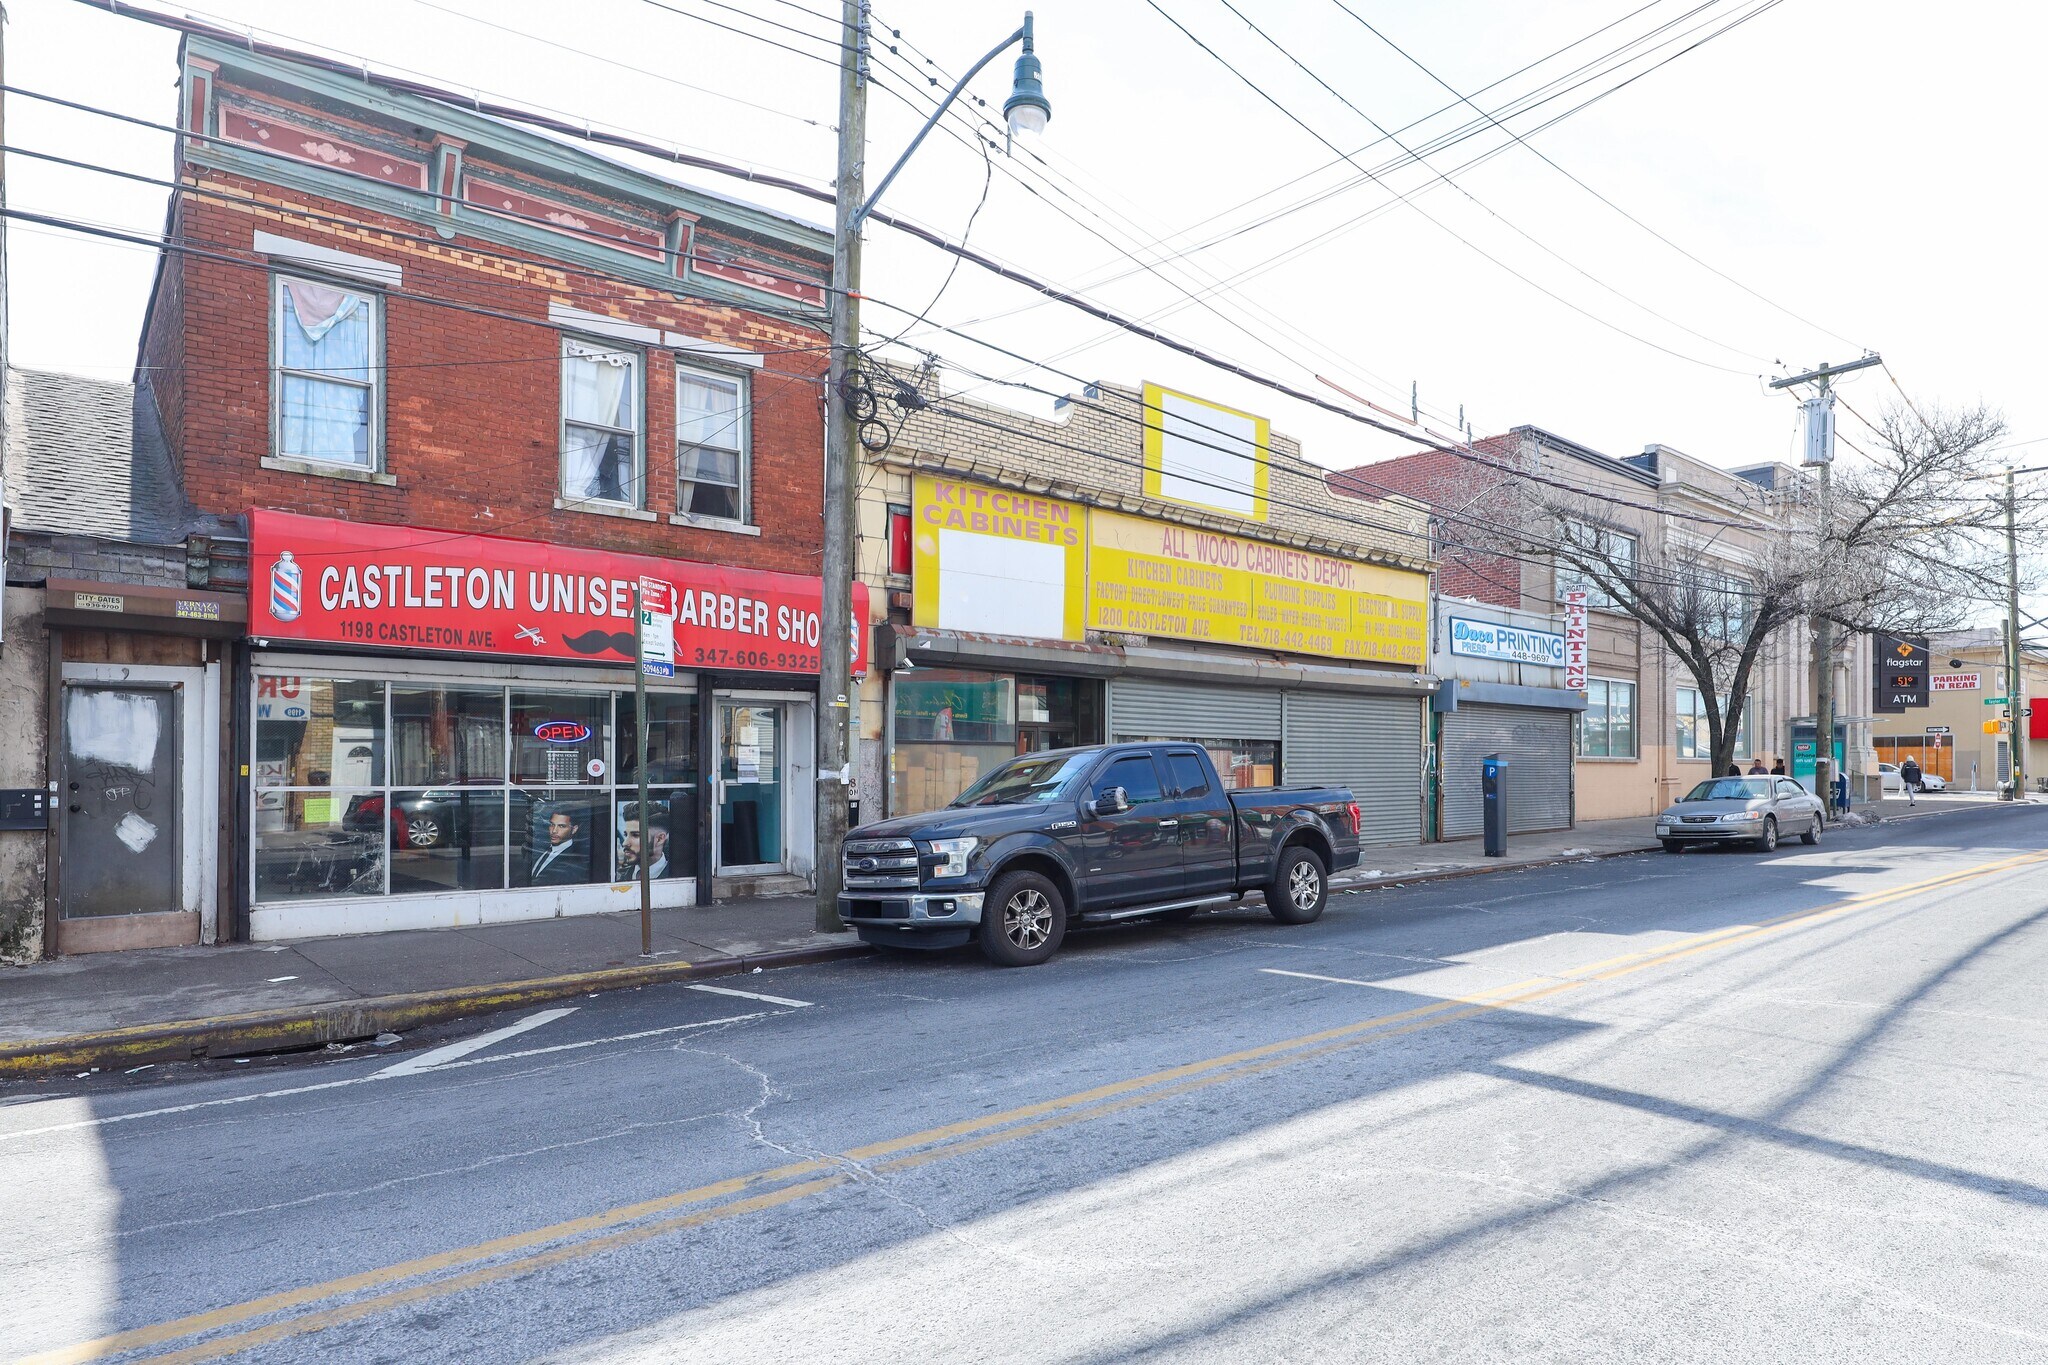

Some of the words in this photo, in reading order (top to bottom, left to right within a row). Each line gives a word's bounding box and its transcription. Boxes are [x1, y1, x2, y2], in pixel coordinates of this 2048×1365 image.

[934, 482, 1070, 524] KITCHEN
[922, 504, 1078, 546] CABINETS
[1162, 527, 1190, 559] ALL
[1195, 532, 1240, 568] WOOD
[1245, 543, 1309, 581] CABINETS
[1127, 558, 1173, 583] KITCHEN
[1176, 566, 1223, 592] CABINETS
[1096, 581, 1128, 601] FACTORY
[1187, 594, 1207, 613] PRICE
[1208, 598, 1248, 618] GUARANTEED
[1264, 581, 1301, 605] PLUMBING
[1303, 589, 1336, 611] SUPPLIES
[1566, 584, 1587, 592] RIGATTI
[178, 600, 218, 609] VERNAZA
[318, 564, 517, 612] CASTLETON
[776, 604, 820, 649] SHO
[1401, 603, 1423, 622] SUPPLY
[643, 611, 651, 625] 2
[1098, 606, 1123, 627] 1200
[1128, 609, 1187, 634] CASTLETON
[1257, 605, 1278, 622] BOILER
[1281, 609, 1299, 626] WATER
[1302, 612, 1322, 629] HEATER
[340, 620, 373, 639] 1198
[378, 622, 464, 646] CASTLETON
[467, 629, 497, 648] AVE.
[1496, 629, 1563, 660] PRINTING
[1566, 592, 1587, 688] PRINTING
[694, 647, 819, 670] 347-606-9325
[1461, 641, 1487, 654] PRESS
[1511, 650, 1550, 663] 448-9697
[1886, 657, 1923, 669] flagstar
[1933, 674, 1978, 683] PARKING
[1892, 694, 1917, 703] ATM
[537, 725, 585, 740] OPEN
[1489, 766, 1496, 777] P
